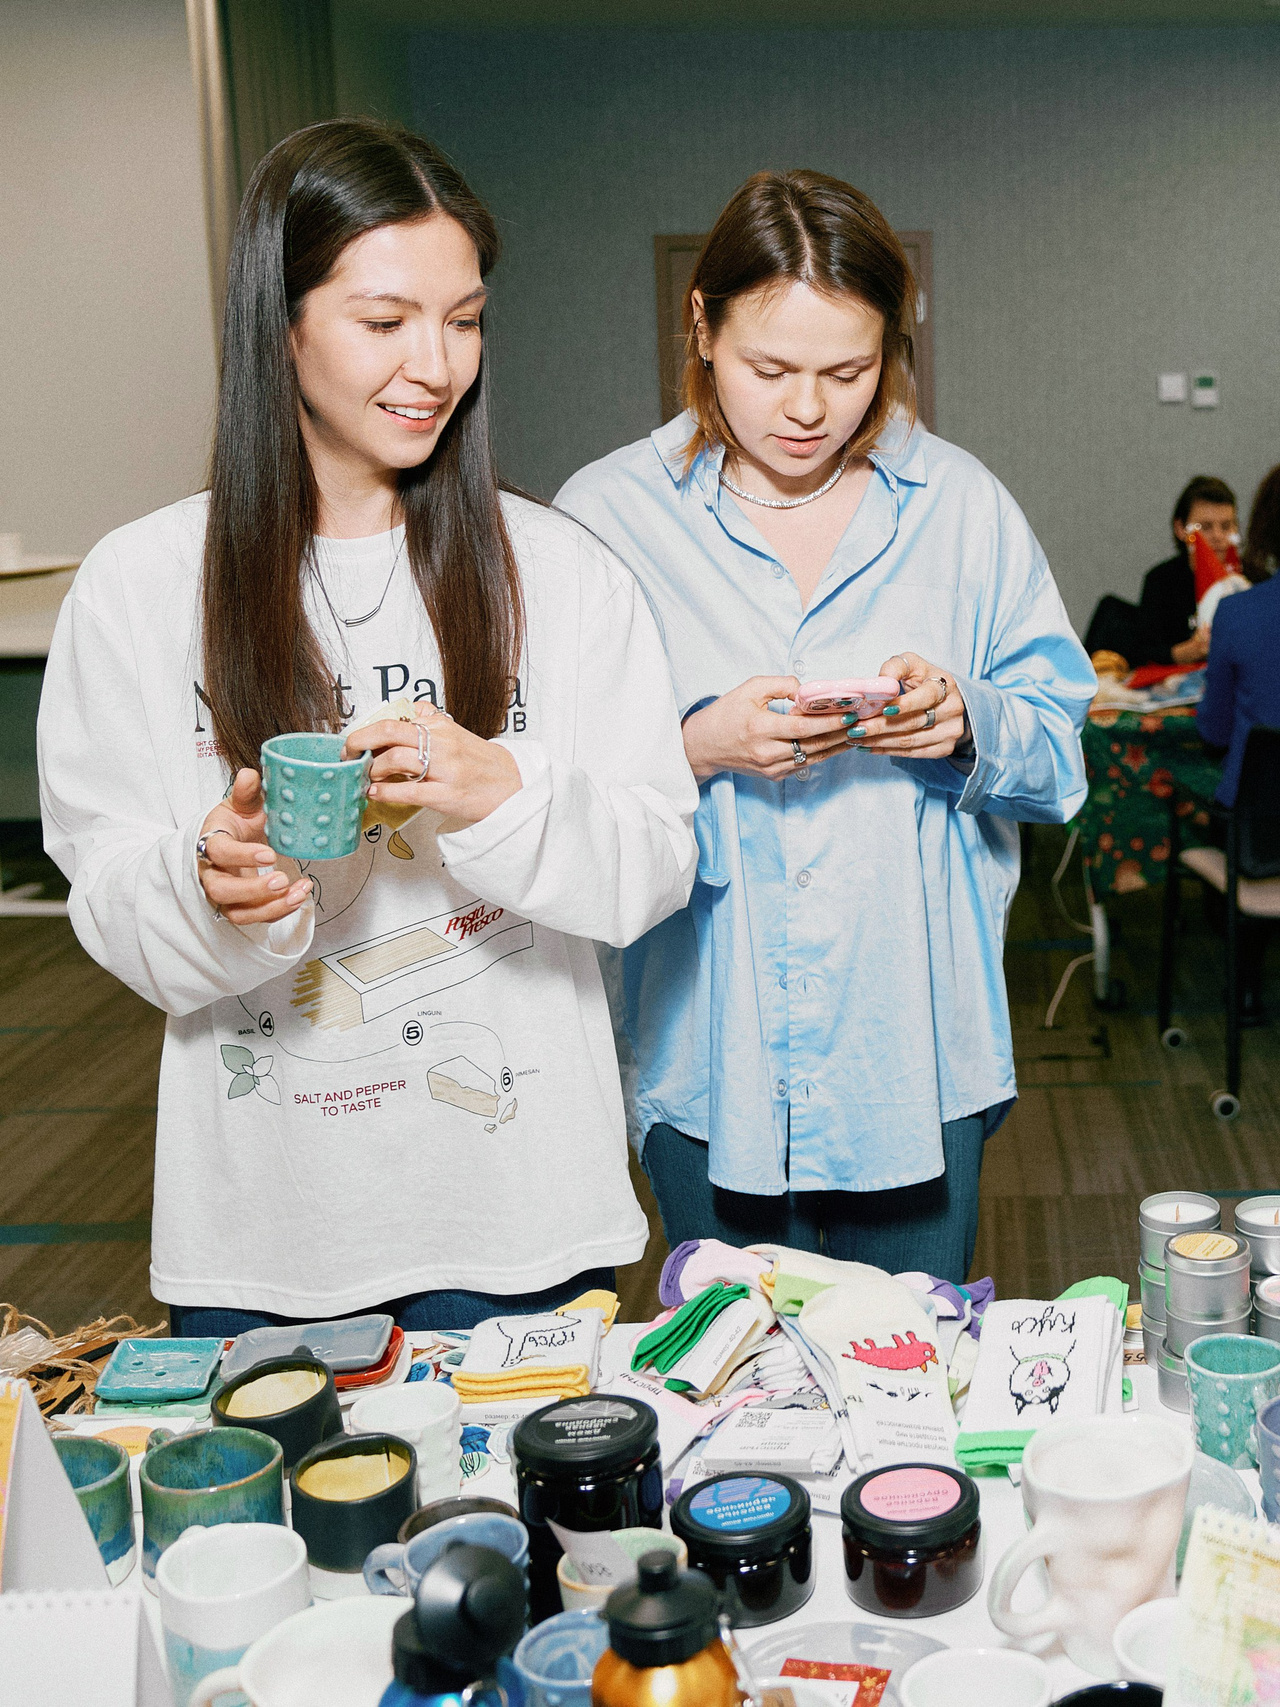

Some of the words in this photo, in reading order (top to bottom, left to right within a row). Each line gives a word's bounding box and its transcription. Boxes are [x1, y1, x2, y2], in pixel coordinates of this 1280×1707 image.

[262, 1017, 273, 1031] 4
[406, 1026, 420, 1040] 5
[503, 1072, 511, 1086] 6
[294, 1093, 322, 1104] SALT
[324, 1090, 353, 1103] AND
[355, 1080, 407, 1098] PEPPER
[320, 1105, 339, 1117] TO
[341, 1098, 382, 1114] TASTE
[873, 1489, 949, 1502] брусничное
[886, 1496, 939, 1507] варенье
[706, 1495, 776, 1515] черничное
[717, 1503, 771, 1520] варенье
